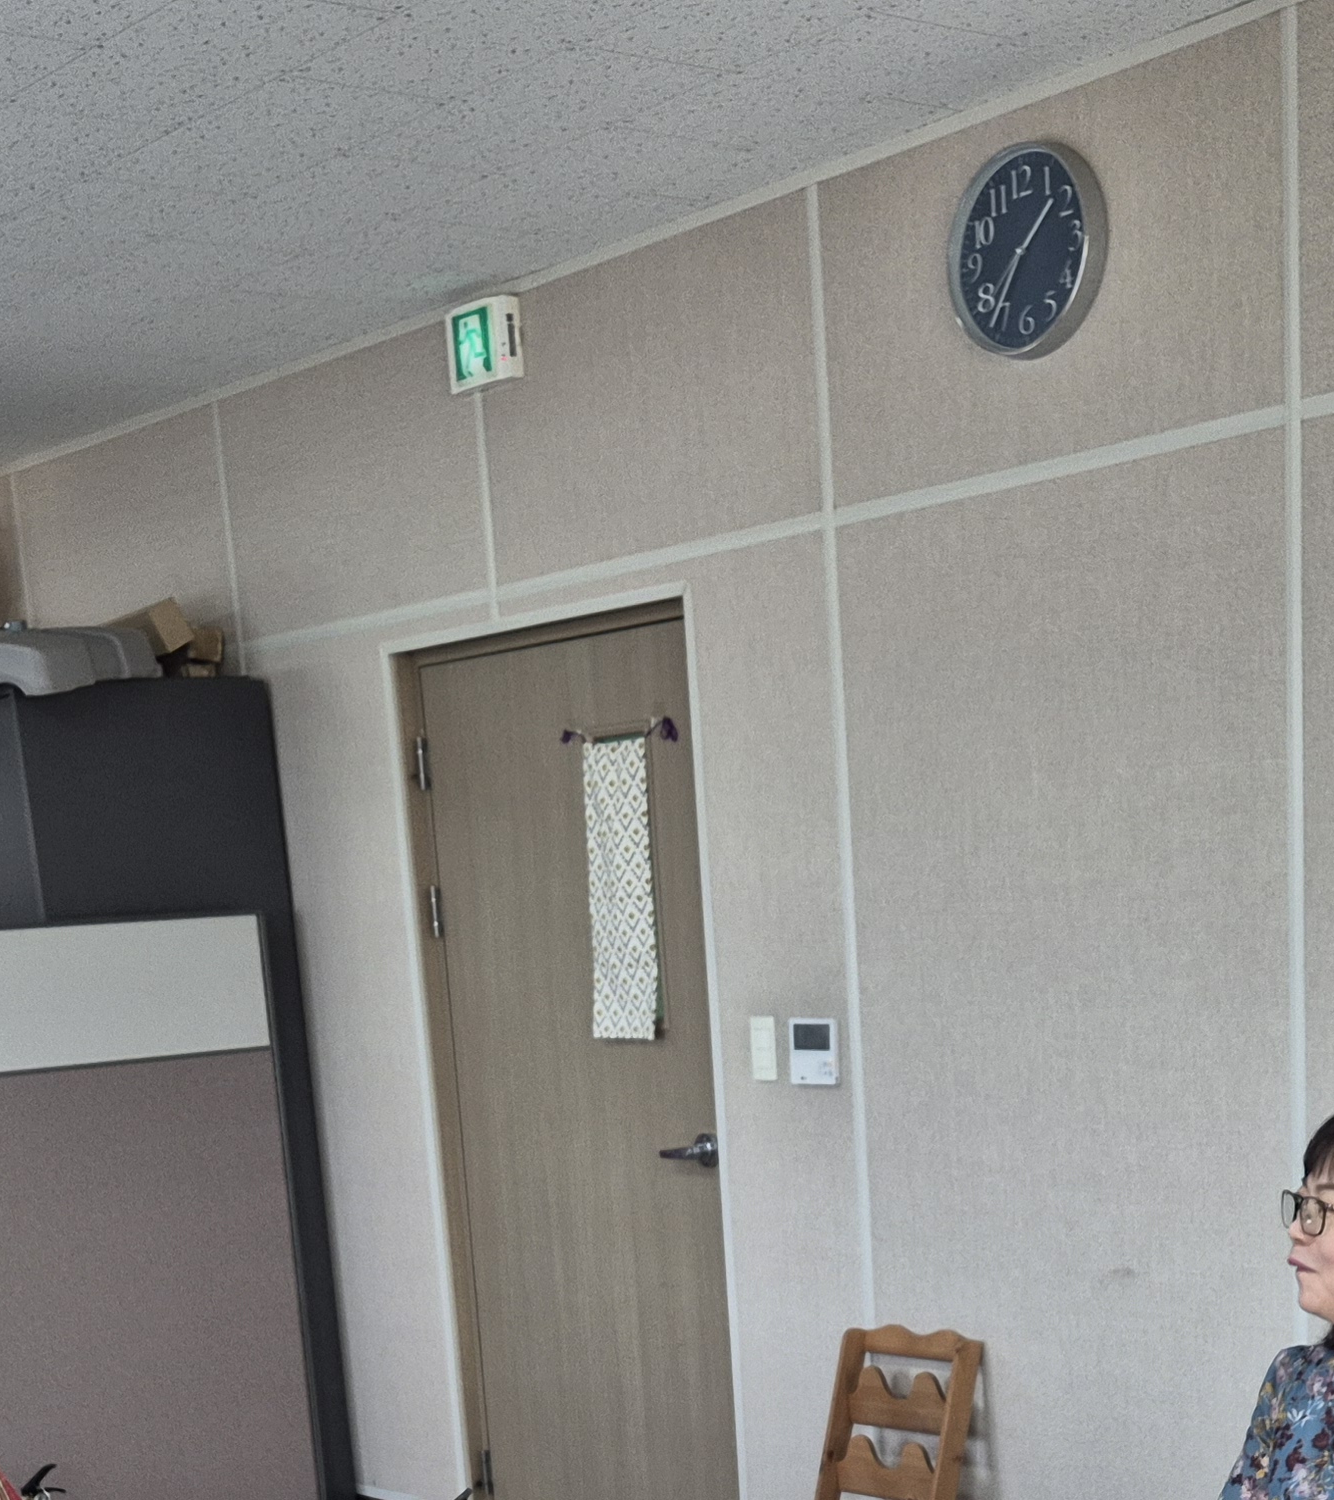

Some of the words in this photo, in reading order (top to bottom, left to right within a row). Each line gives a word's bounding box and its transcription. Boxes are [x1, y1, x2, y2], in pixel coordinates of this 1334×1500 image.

[1010, 165, 1033, 200] 12
[1043, 166, 1052, 197] 1
[989, 184, 1008, 218] 11
[1058, 184, 1074, 218] 2
[973, 216, 994, 249] 10
[1067, 219, 1084, 251] 3
[967, 253, 983, 284] 9
[1059, 258, 1074, 289] 4
[976, 282, 995, 313] 8
[1043, 290, 1057, 322] 5
[998, 301, 1011, 332] 7
[1018, 304, 1036, 335] 6
